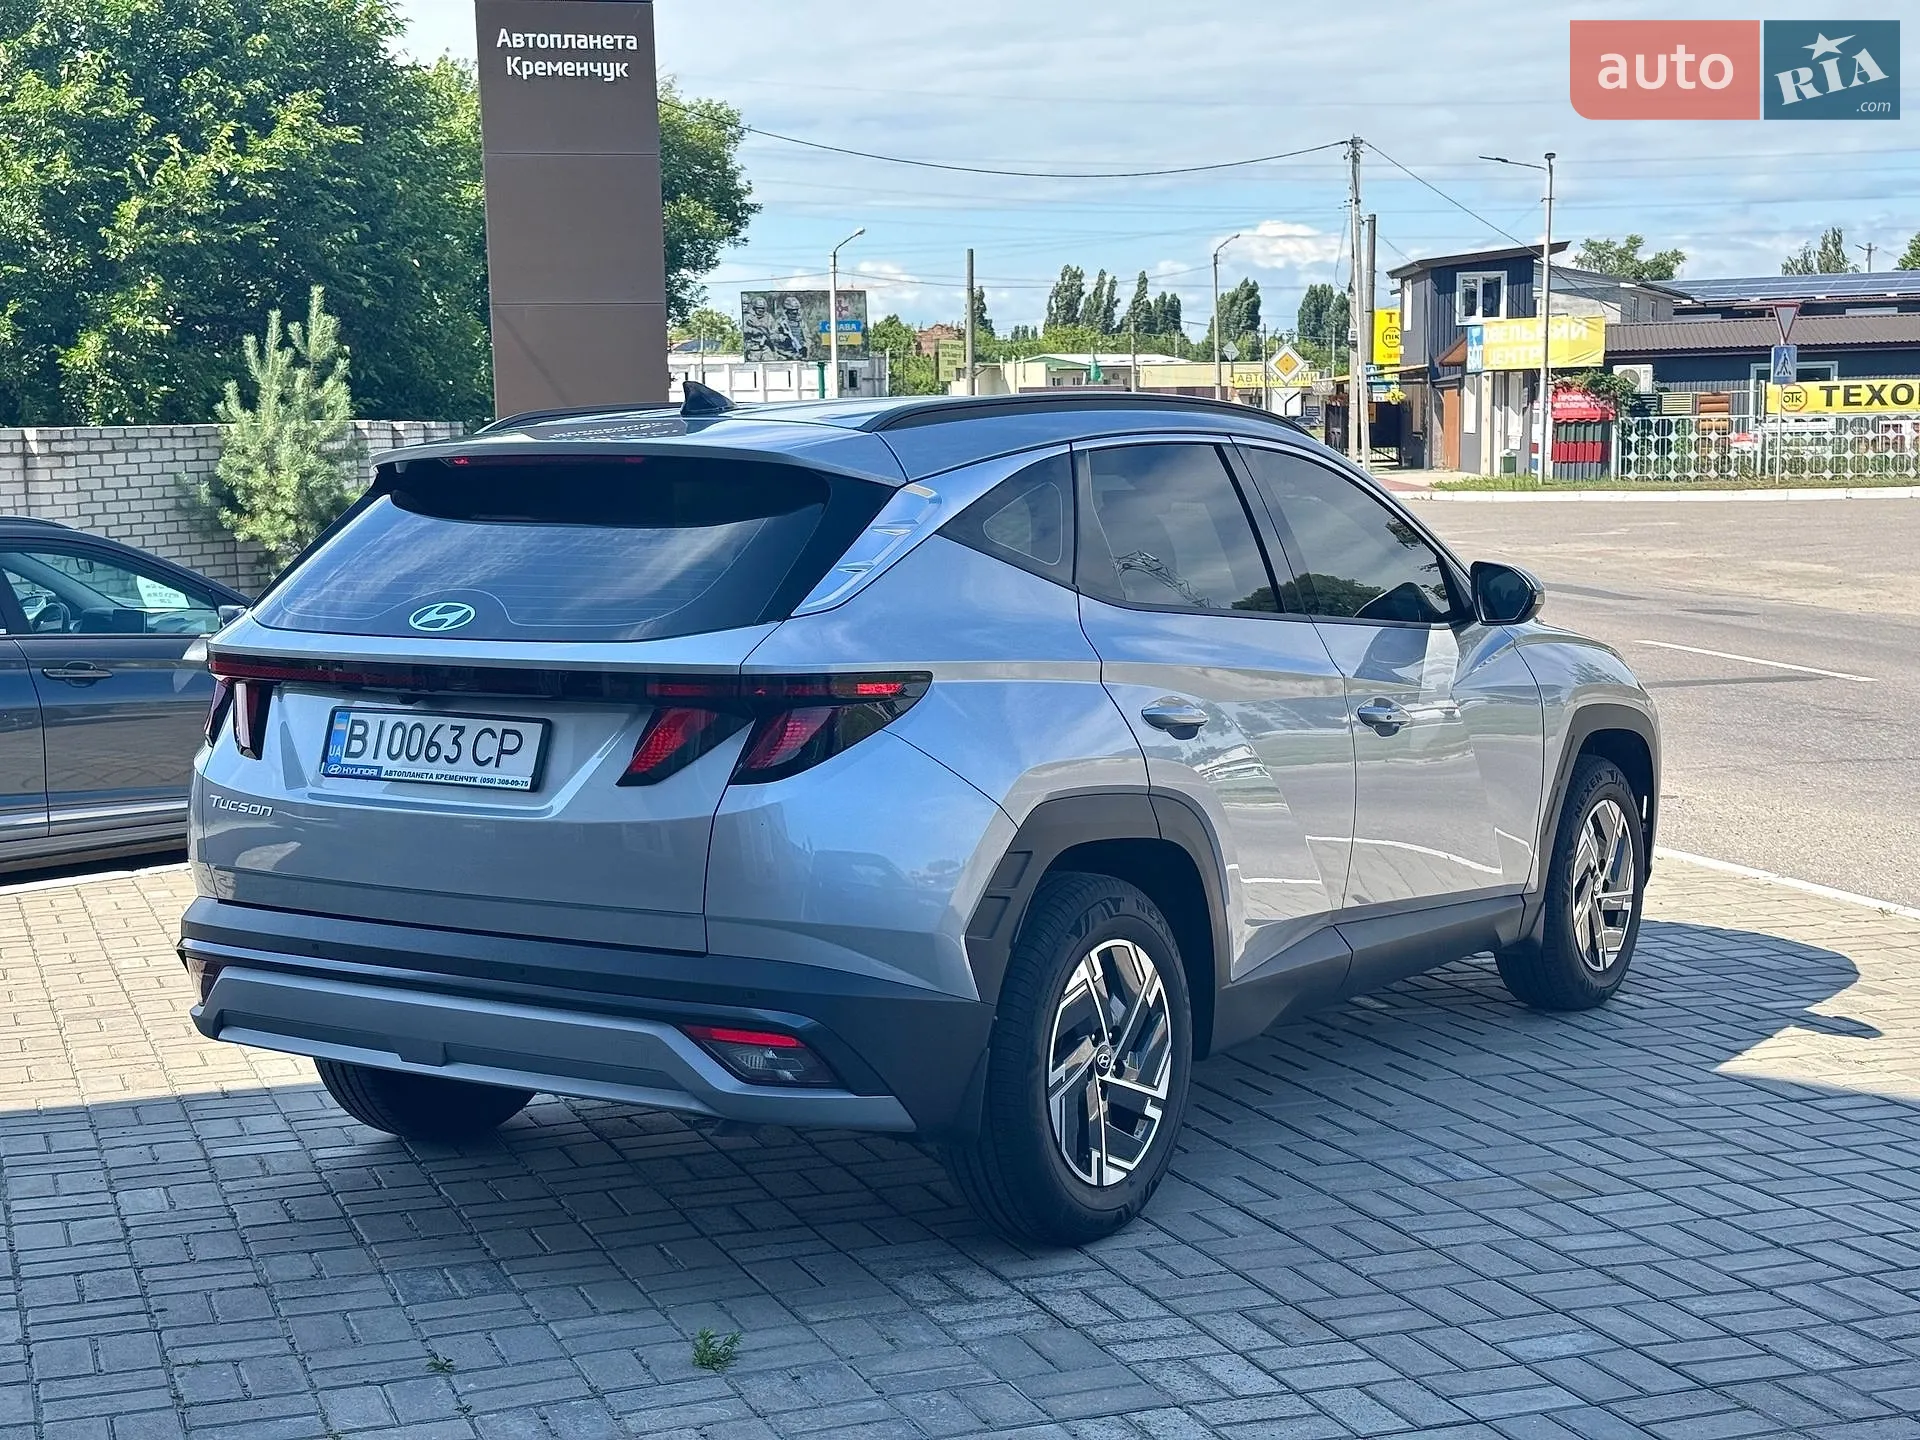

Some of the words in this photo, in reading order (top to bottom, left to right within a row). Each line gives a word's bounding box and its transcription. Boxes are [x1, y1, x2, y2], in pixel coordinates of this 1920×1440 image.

[496, 27, 639, 50] Автопланета
[505, 55, 630, 82] Кременчук
[824, 322, 858, 332] САВА
[1819, 383, 1920, 407] ТЕХО
[329, 744, 342, 758] UA
[471, 727, 524, 768] CP
[341, 766, 380, 777] HYUNDAI
[383, 769, 434, 781] АВТОПЛАНЕТА
[435, 773, 478, 784] КРЕМЕНЧУК
[208, 793, 274, 817] Tucson
[1574, 771, 1604, 820] NEXEN
